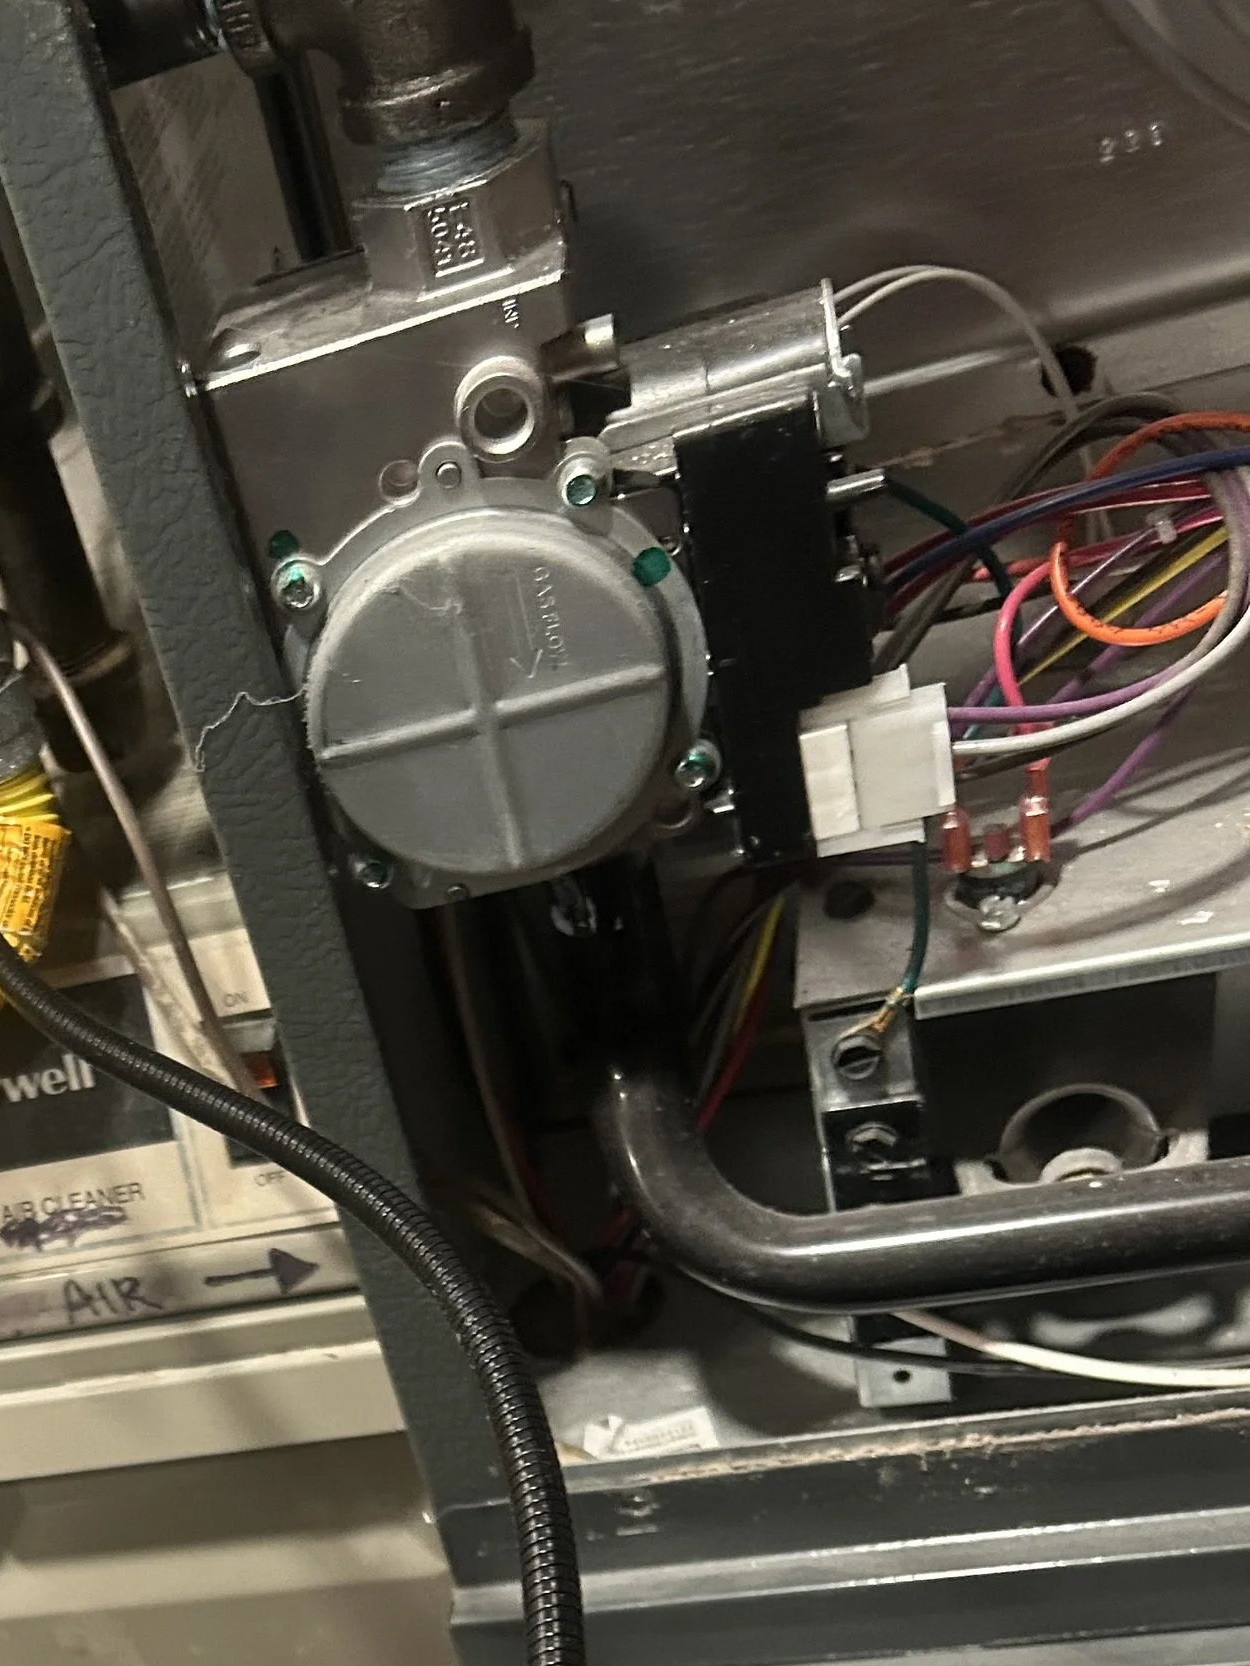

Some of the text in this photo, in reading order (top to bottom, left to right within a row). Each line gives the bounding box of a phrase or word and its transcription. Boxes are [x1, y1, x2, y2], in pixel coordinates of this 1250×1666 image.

[223, 991, 251, 1008] ON
[252, 1168, 287, 1188] OFF
[61, 1275, 163, 1325] AIR
